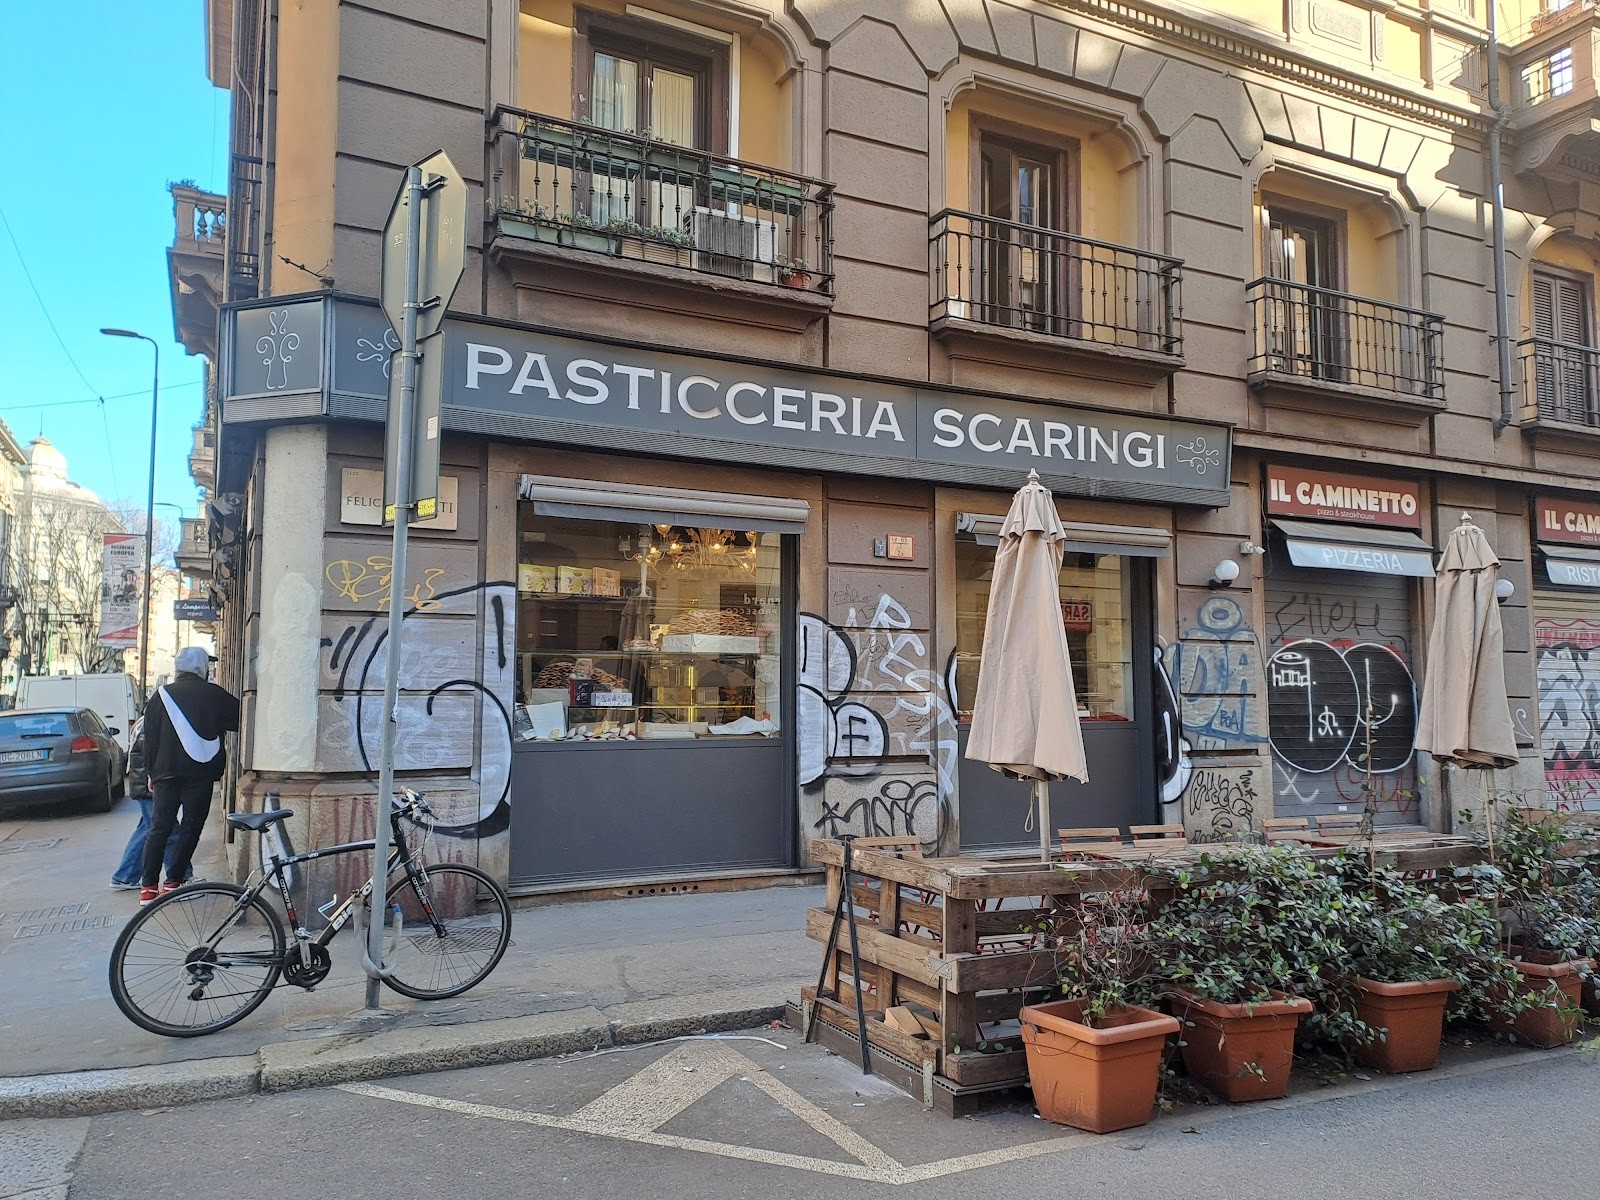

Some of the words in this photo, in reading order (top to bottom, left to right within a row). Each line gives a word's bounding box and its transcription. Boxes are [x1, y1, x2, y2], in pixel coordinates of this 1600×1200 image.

[464, 342, 906, 442] PASTICCERIA
[932, 408, 1166, 469] SCARINGI
[346, 496, 381, 508] FELIC
[1270, 478, 1291, 503] IL
[1296, 481, 1417, 516] CAMINETTO
[1317, 508, 1335, 516] pizza
[1340, 510, 1376, 521] steakhouse
[1544, 509, 1561, 531] IL
[1321, 547, 1404, 572] PIZZERIA
